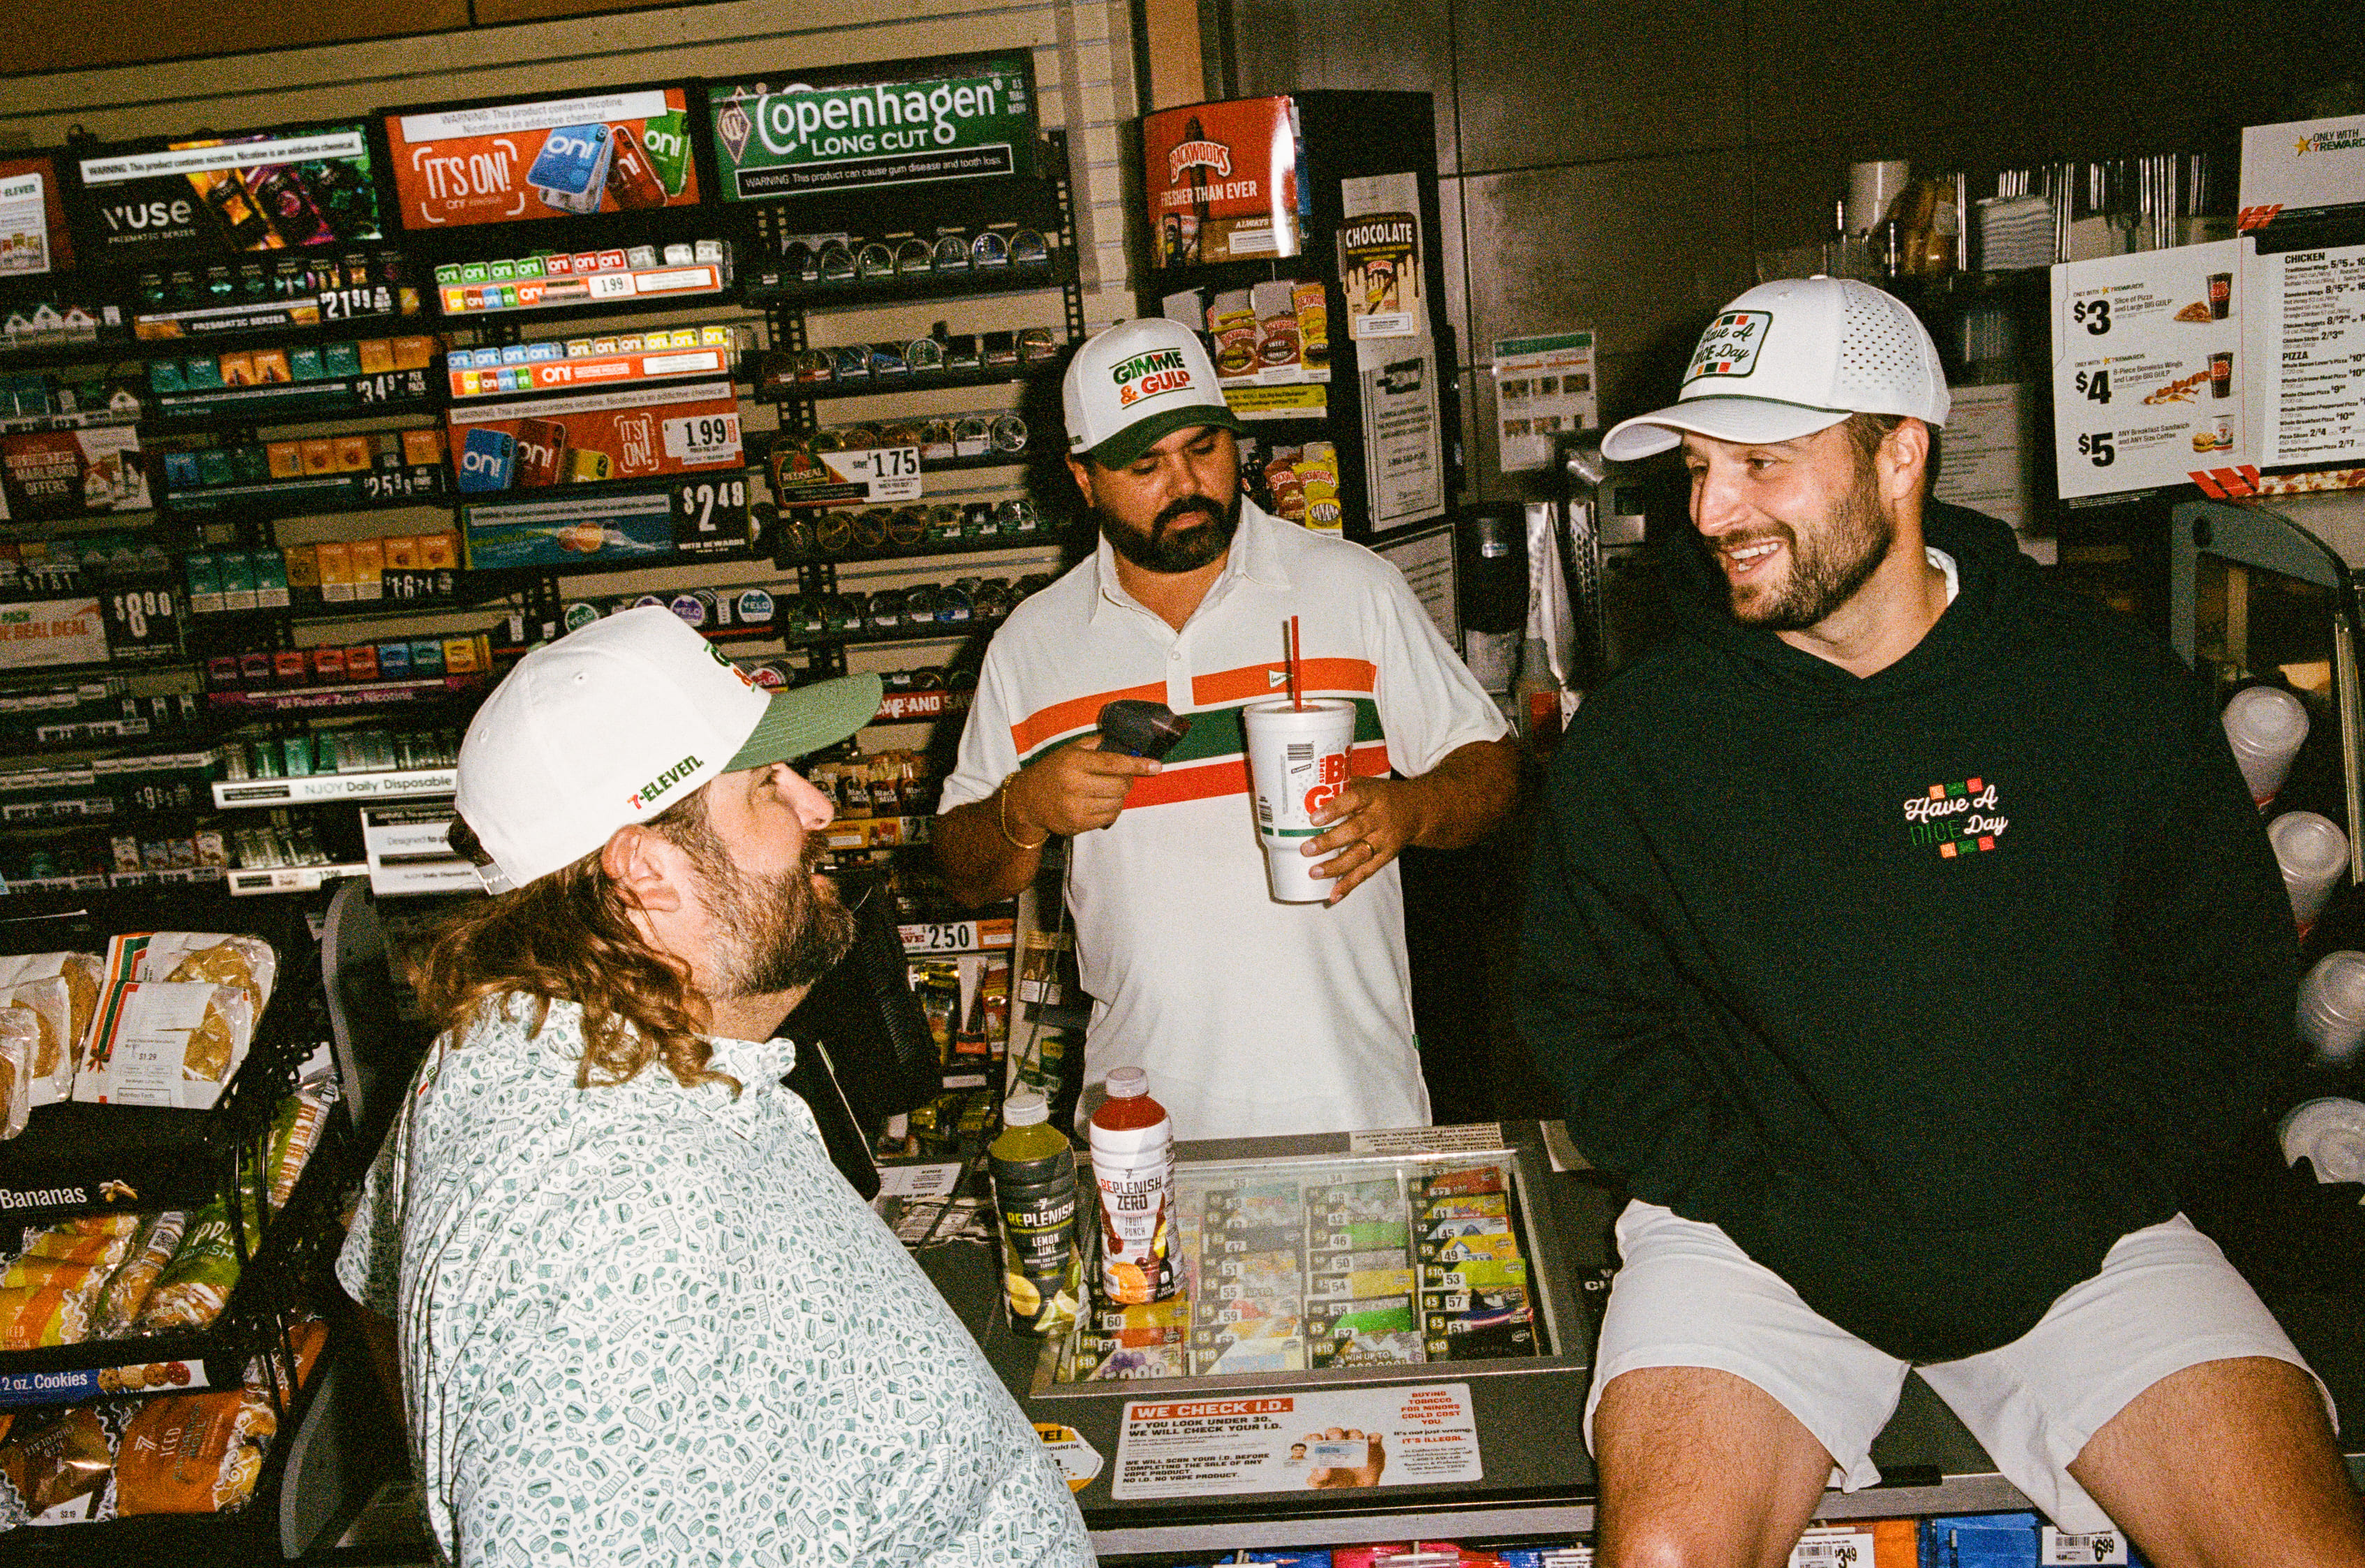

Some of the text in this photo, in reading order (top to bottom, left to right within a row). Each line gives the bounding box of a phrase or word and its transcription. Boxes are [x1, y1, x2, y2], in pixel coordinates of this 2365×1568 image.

[493, 102, 586, 119] This product contains
[462, 117, 564, 134] Nicotine addictive
[812, 128, 929, 156] LONG CUT
[2313, 128, 2359, 142] ONLY WITH
[793, 156, 982, 184] This product can cause gum disease and tooth
[1169, 140, 1231, 184] BACKWOODS
[469, 151, 512, 195] ON!
[1161, 180, 1258, 207] FRESHER THAN EVER
[1346, 223, 1413, 249] CHOCOLATE
[2285, 252, 2325, 264] CHICKEN
[2127, 303, 2144, 311] Large
[2073, 299, 2112, 336] $3
[1732, 323, 1755, 341] A
[1716, 342, 1750, 360] Day
[2283, 351, 2308, 361] PIZZA
[1112, 351, 1186, 385] GIMME
[2113, 360, 2183, 376] 8-Piece Boneless Wings
[2125, 373, 2142, 383] Large
[2143, 371, 2153, 380] BIG
[1120, 370, 1191, 405] & GULP
[2075, 370, 2112, 405] $4
[2130, 426, 2160, 436] Breakfast
[2160, 422, 2190, 432] Sandwich
[2130, 435, 2142, 443] ANY
[2144, 434, 2156, 442] Size
[2156, 432, 2176, 441] Coffee
[2078, 431, 2115, 468] $5
[305, 776, 452, 794] NJOY Daily Disposable
[1904, 784, 1999, 824] Have A
[1964, 815, 2009, 836] Day
[138, 1052, 157, 1061] $1.29
[1100, 1176, 1163, 1195] REPLENISH
[0, 1185, 88, 1210] Bananas
[1117, 1193, 1149, 1211] ZERO
[1006, 1200, 1075, 1227] REPLENISH
[1125, 1216, 1143, 1225] FRUIT
[1032, 1233, 1059, 1248] LEMON
[1125, 1227, 1145, 1238] PUNCH
[1333, 1236, 1346, 1245] 46
[1038, 1243, 1056, 1256] LIME
[1444, 1250, 1459, 1261] 49
[1224, 1264, 1238, 1275] 51
[1332, 1281, 1346, 1292] 54
[1446, 1274, 1460, 1285] 53
[1223, 1287, 1237, 1298] 55
[1448, 1298, 1462, 1307] 57
[1107, 1315, 1122, 1327] 60
[1223, 1310, 1237, 1321] 59
[13, 1378, 33, 1391] oz.
[34, 1370, 89, 1391] Cookies
[1137, 1399, 1288, 1419] WE CHECK I.D.
[1172, 1419, 1202, 1428] LOOK
[1207, 1417, 1248, 1426] UNDER
[1228, 1423, 1260, 1432] YOUR
[1150, 1467, 1193, 1476] PRODUCT.
